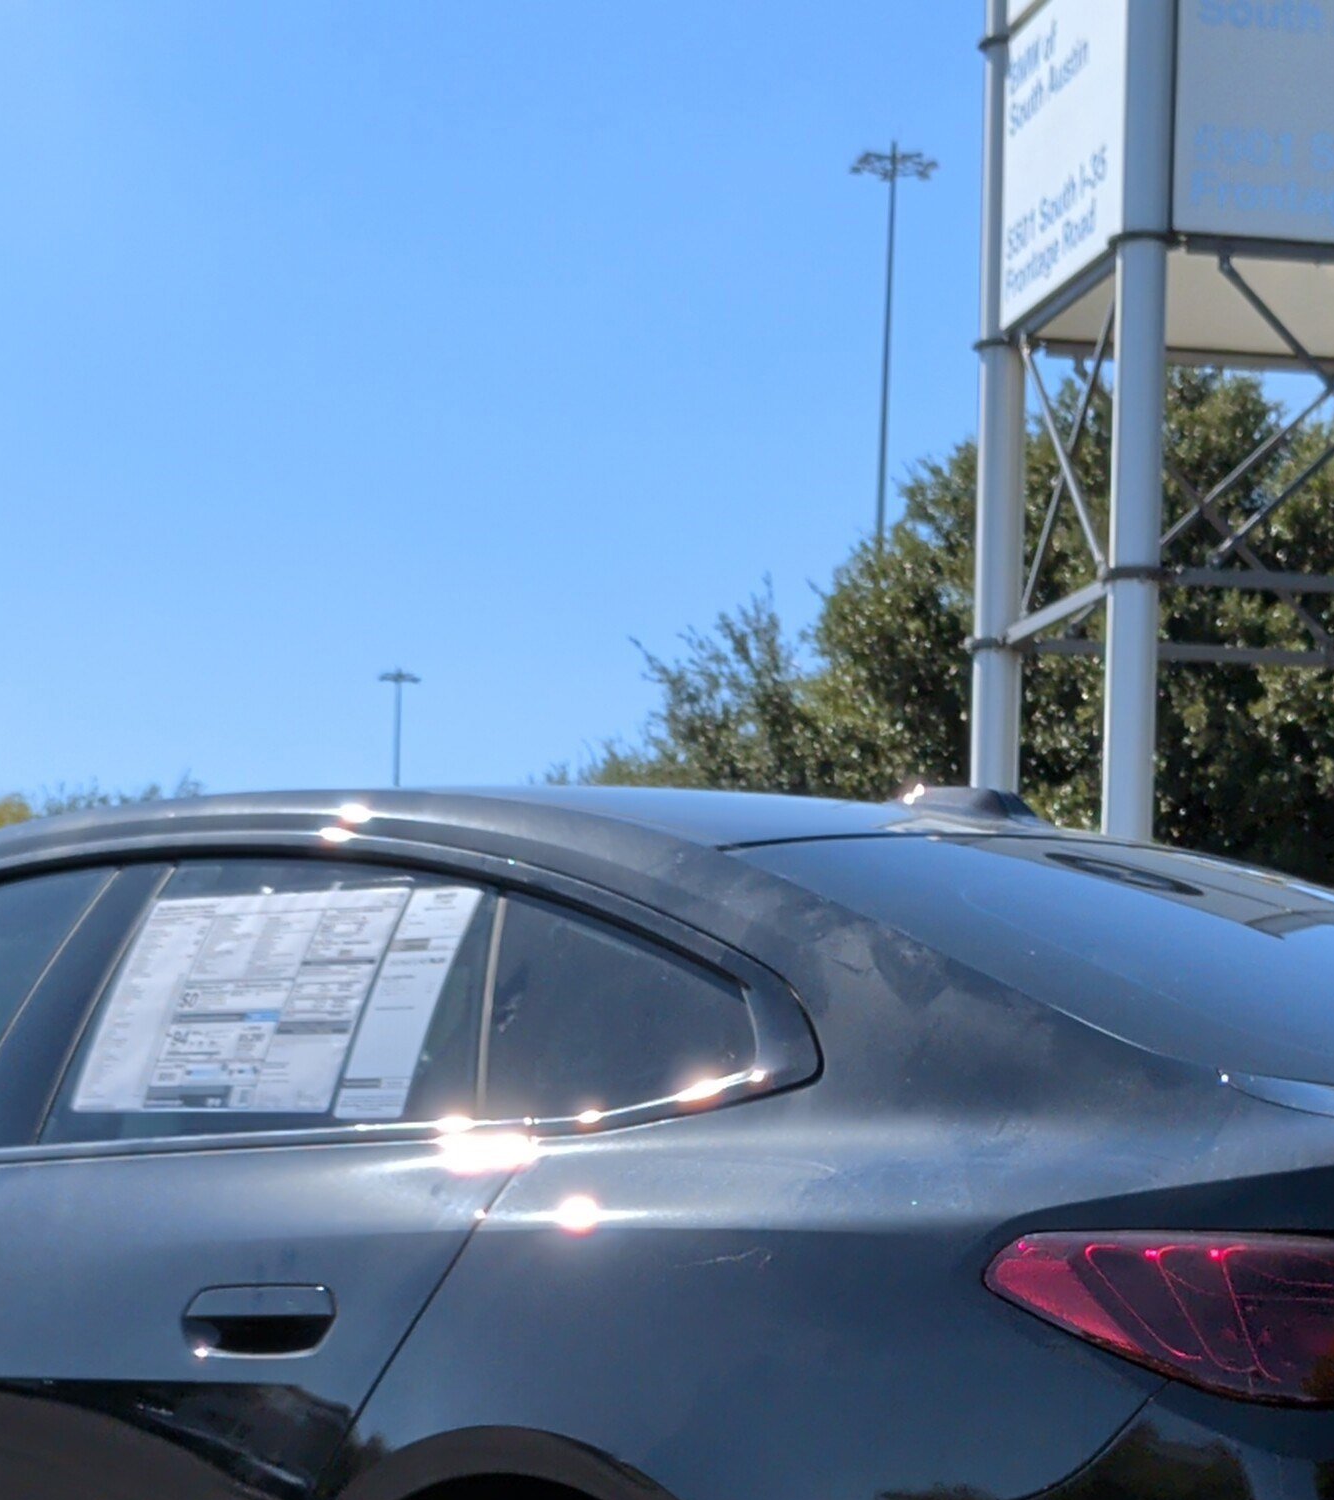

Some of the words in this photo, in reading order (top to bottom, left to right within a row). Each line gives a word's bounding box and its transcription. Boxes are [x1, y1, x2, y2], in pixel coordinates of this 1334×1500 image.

[1043, 19, 1057, 62] of
[1198, 0, 1323, 34] South
[1009, 78, 1044, 137] South
[1048, 38, 1090, 94] Austin
[1038, 174, 1077, 232] South
[1006, 240, 1061, 299] Frontage
[1062, 197, 1096, 250] Road
